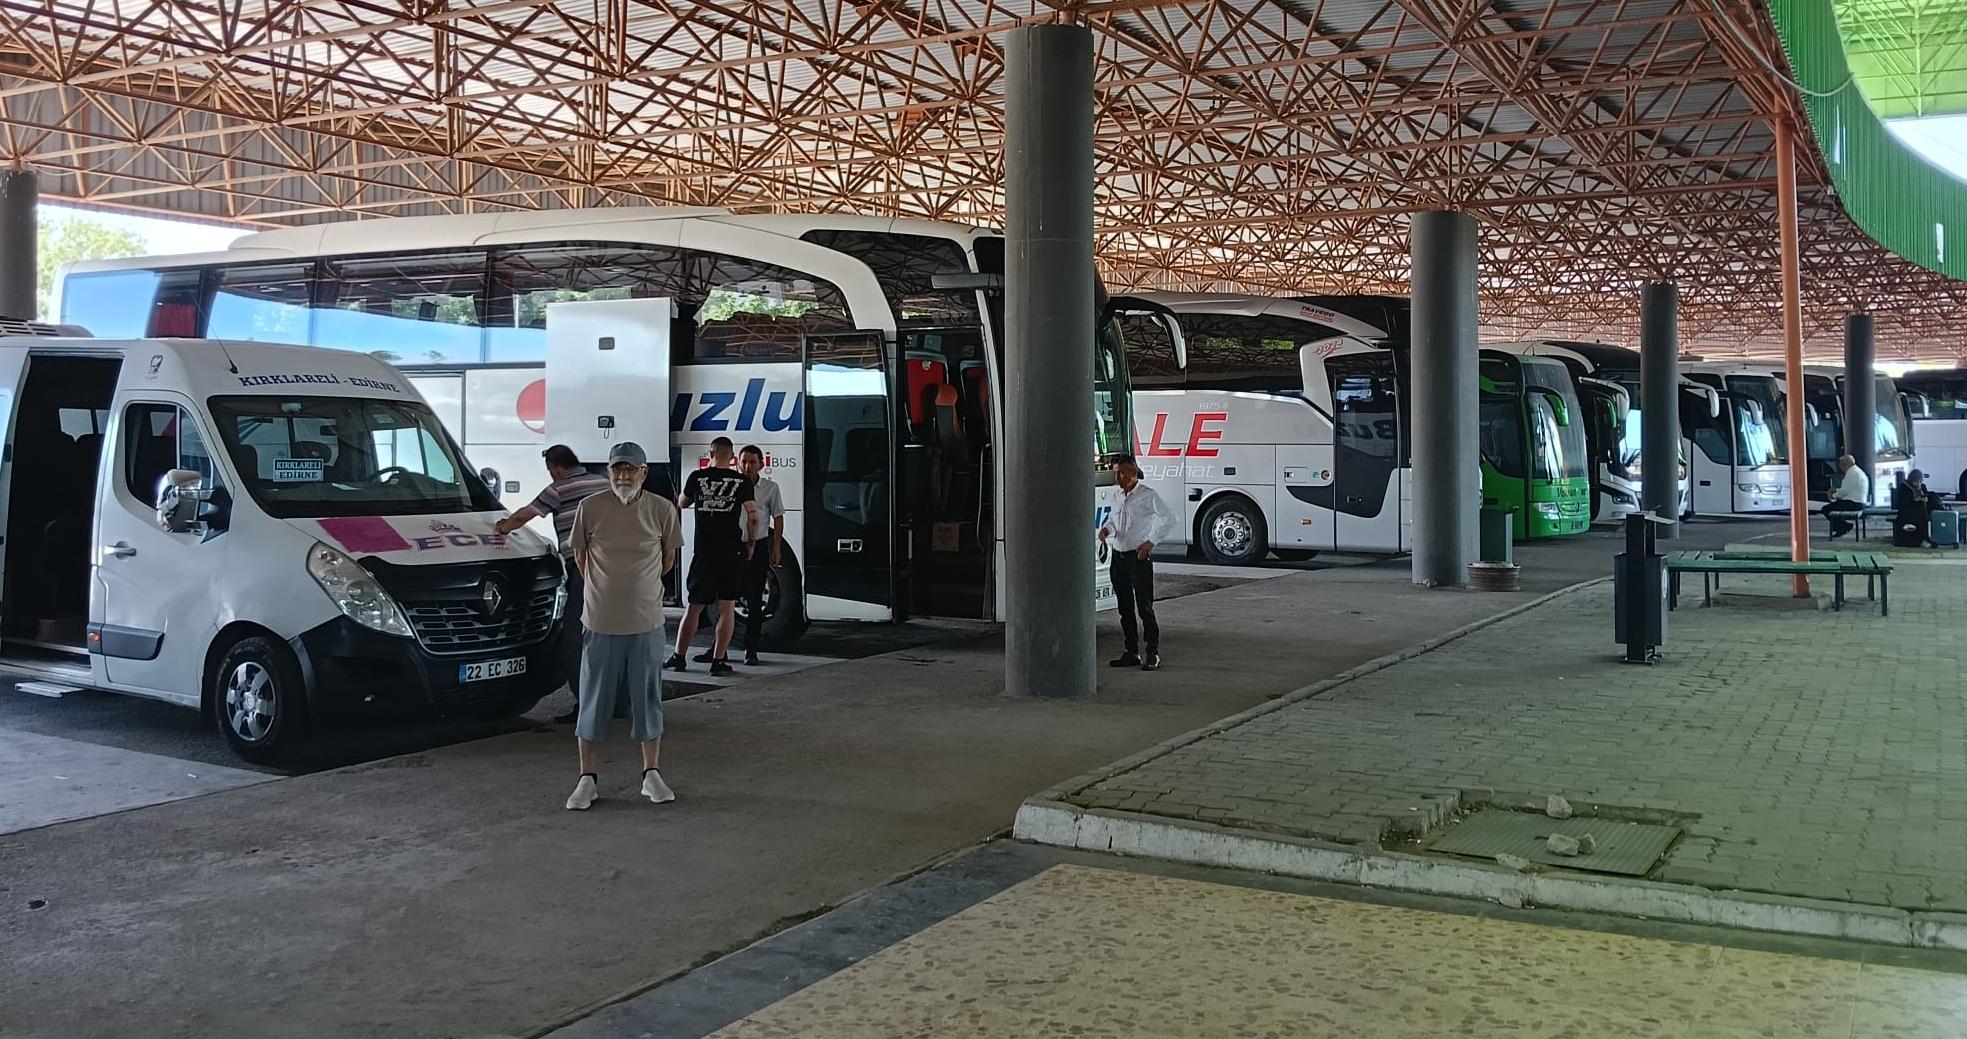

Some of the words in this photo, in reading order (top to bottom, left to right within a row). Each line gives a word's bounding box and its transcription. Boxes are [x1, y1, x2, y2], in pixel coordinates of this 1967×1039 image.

[349, 376, 401, 393] EDİRNE
[1144, 462, 1217, 481] eyahat
[467, 665, 482, 680] 22
[488, 662, 501, 677] EC
[506, 658, 525, 674] 326
